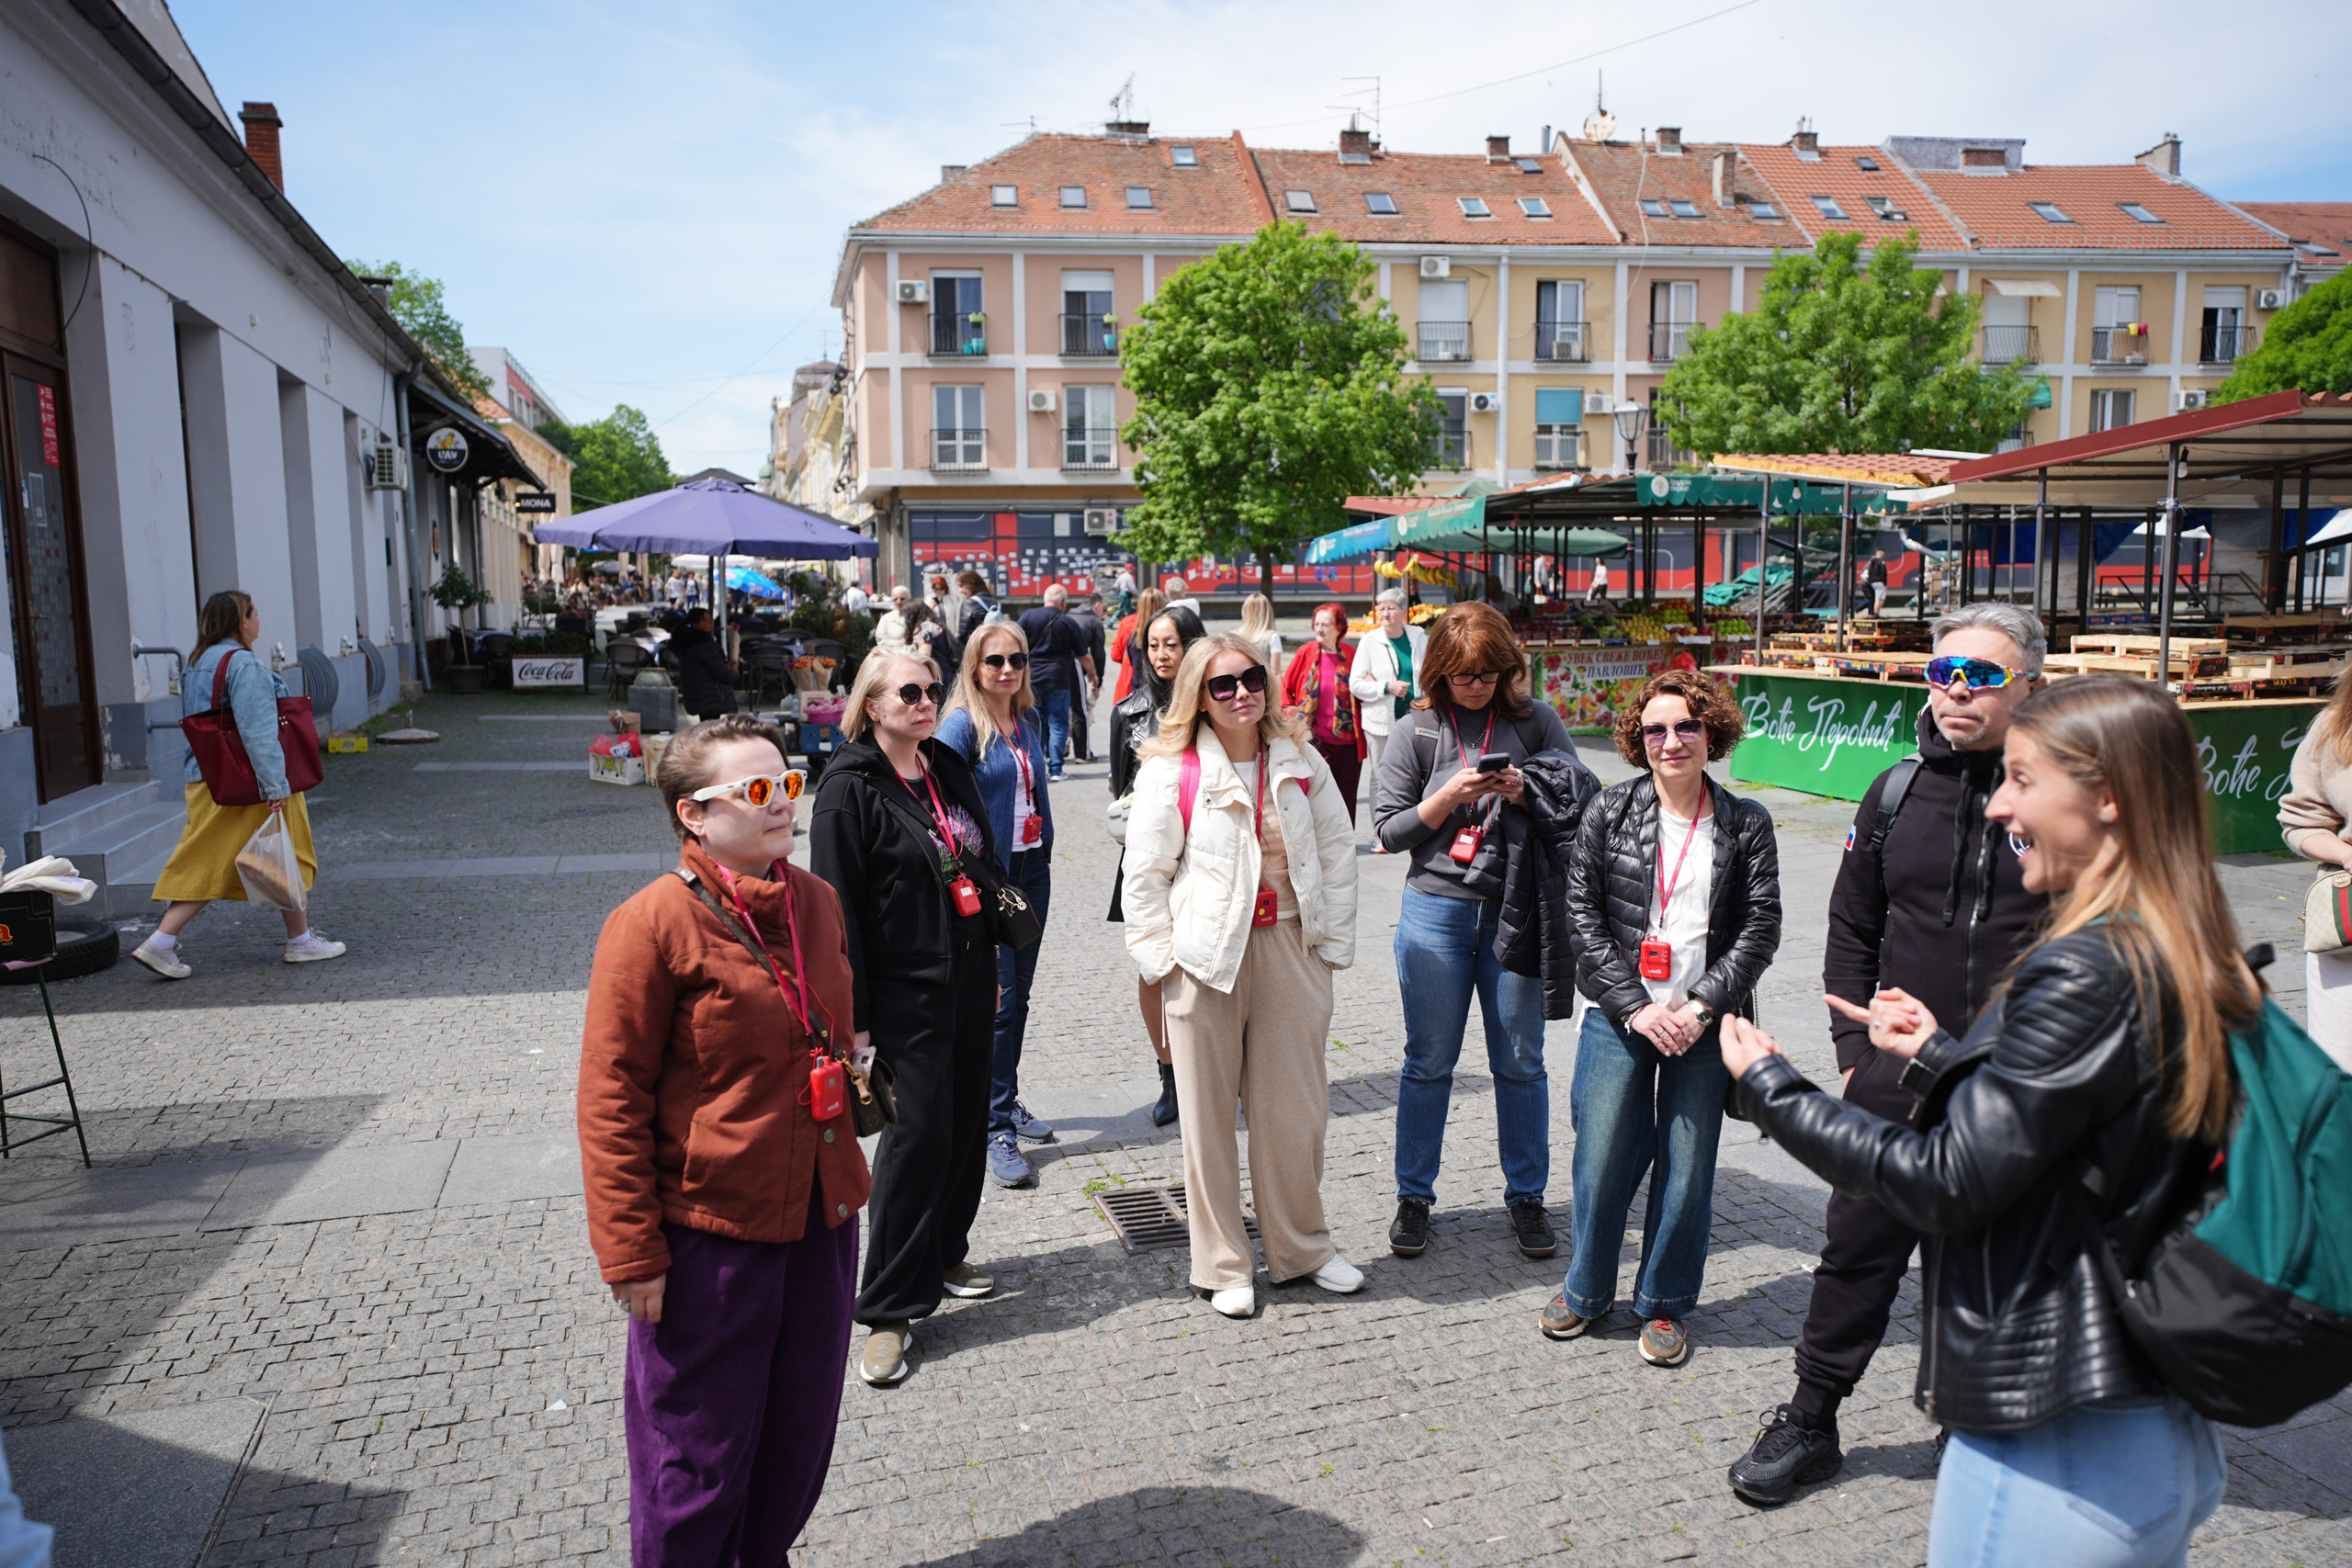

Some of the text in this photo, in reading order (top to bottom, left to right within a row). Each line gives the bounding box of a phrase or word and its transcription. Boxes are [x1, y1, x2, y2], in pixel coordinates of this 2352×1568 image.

[520, 499, 550, 507] MONA
[1567, 652, 1594, 664] УВЕК
[1596, 650, 1631, 663] СВЕЖЕ
[518, 661, 576, 680] Coca-Cola
[1587, 663, 1645, 678] ПАВЛОВИЋ
[1741, 692, 1905, 772] Воће Перовић
